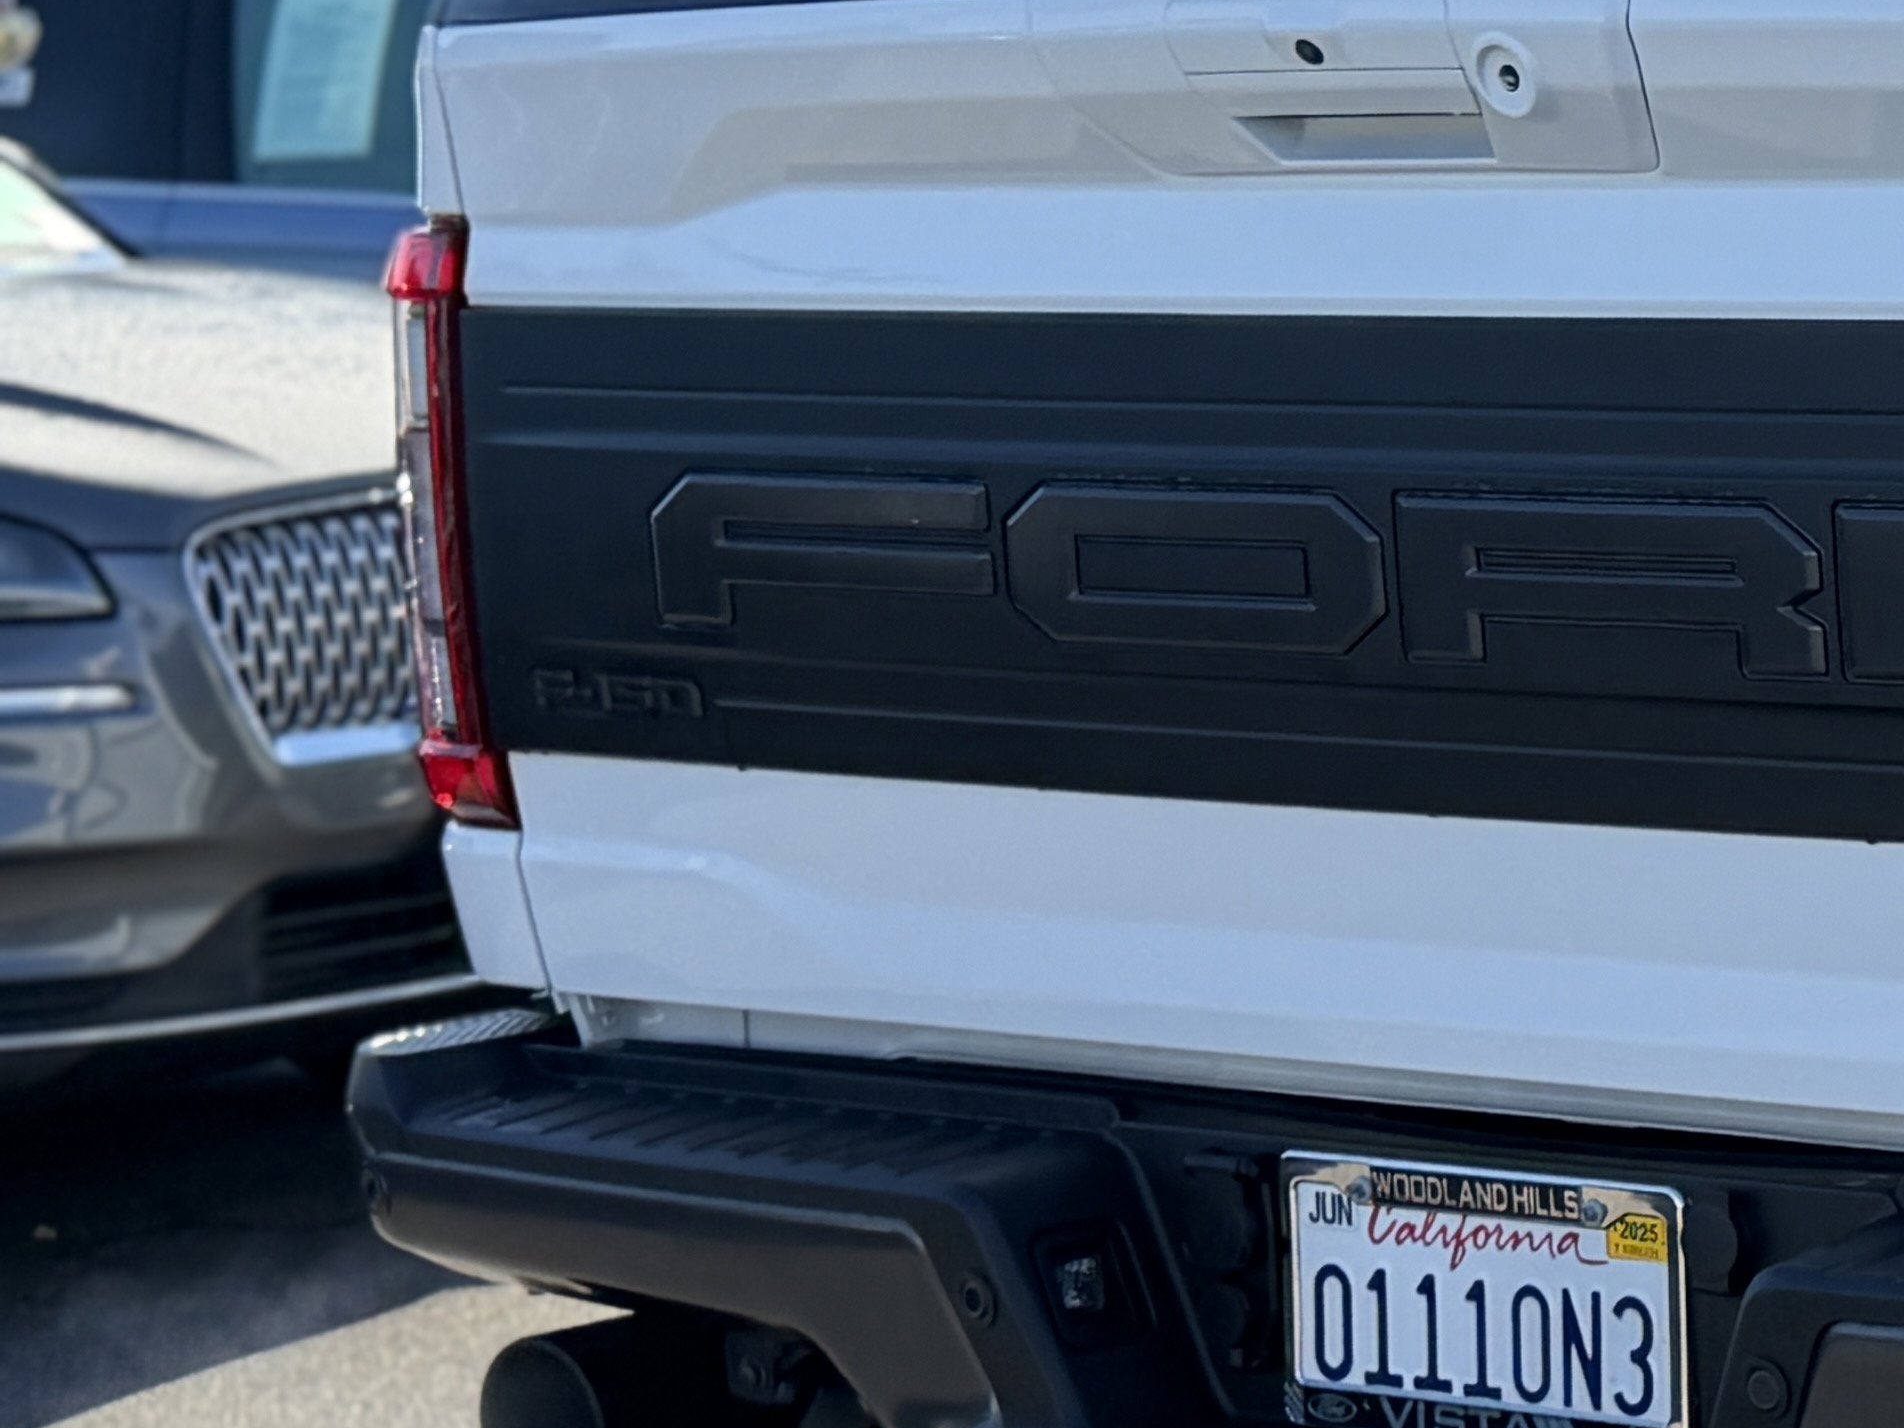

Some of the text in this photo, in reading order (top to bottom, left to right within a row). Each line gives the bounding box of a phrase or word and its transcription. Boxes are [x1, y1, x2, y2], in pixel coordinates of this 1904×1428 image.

[1308, 1190, 1354, 1227] JUN
[1371, 1170, 1580, 1221] WOODLAND HILLS
[1367, 1203, 1609, 1271] California
[1619, 1219, 1660, 1244] 2025
[1313, 1262, 1655, 1417] 01110N3
